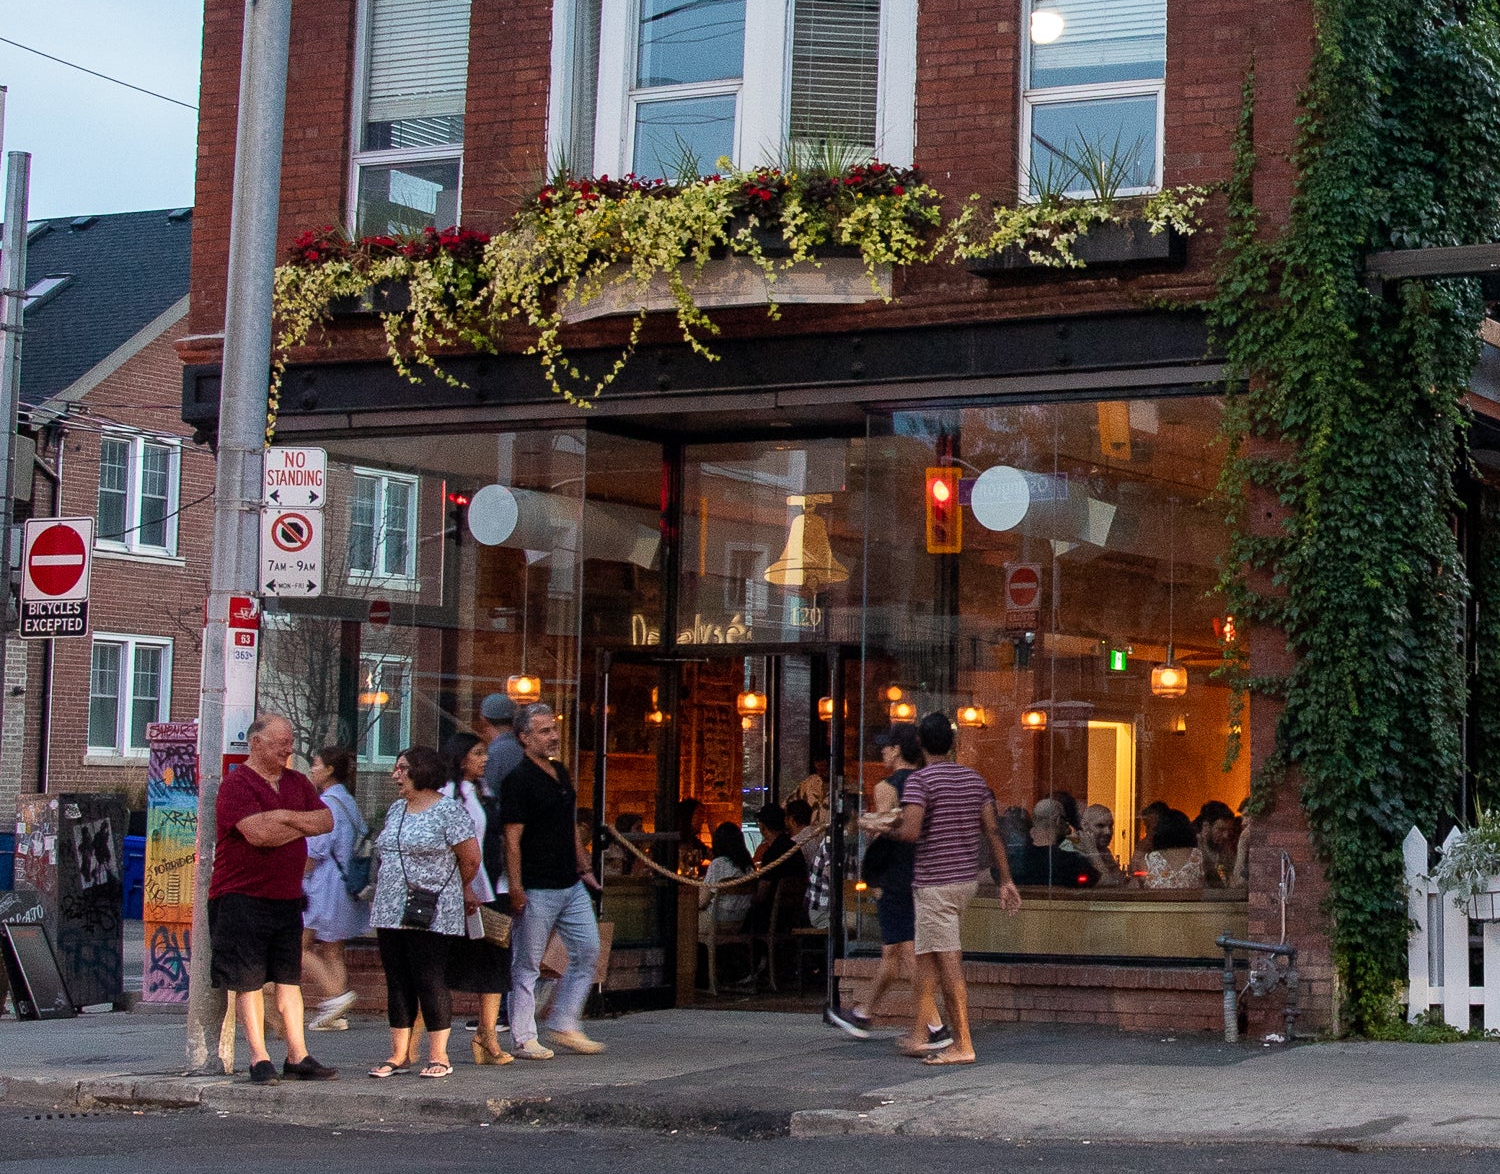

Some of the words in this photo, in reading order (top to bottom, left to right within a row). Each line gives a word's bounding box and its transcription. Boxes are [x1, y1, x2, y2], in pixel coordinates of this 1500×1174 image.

[284, 451, 306, 468] NO
[267, 469, 323, 487] STANDING
[268, 560, 287, 571] 7AM
[296, 560, 316, 571] 9AM
[28, 602, 82, 616] BICYCLES
[792, 607, 822, 627] 120
[25, 618, 83, 632] EXCEPTED
[240, 634, 251, 644] 63
